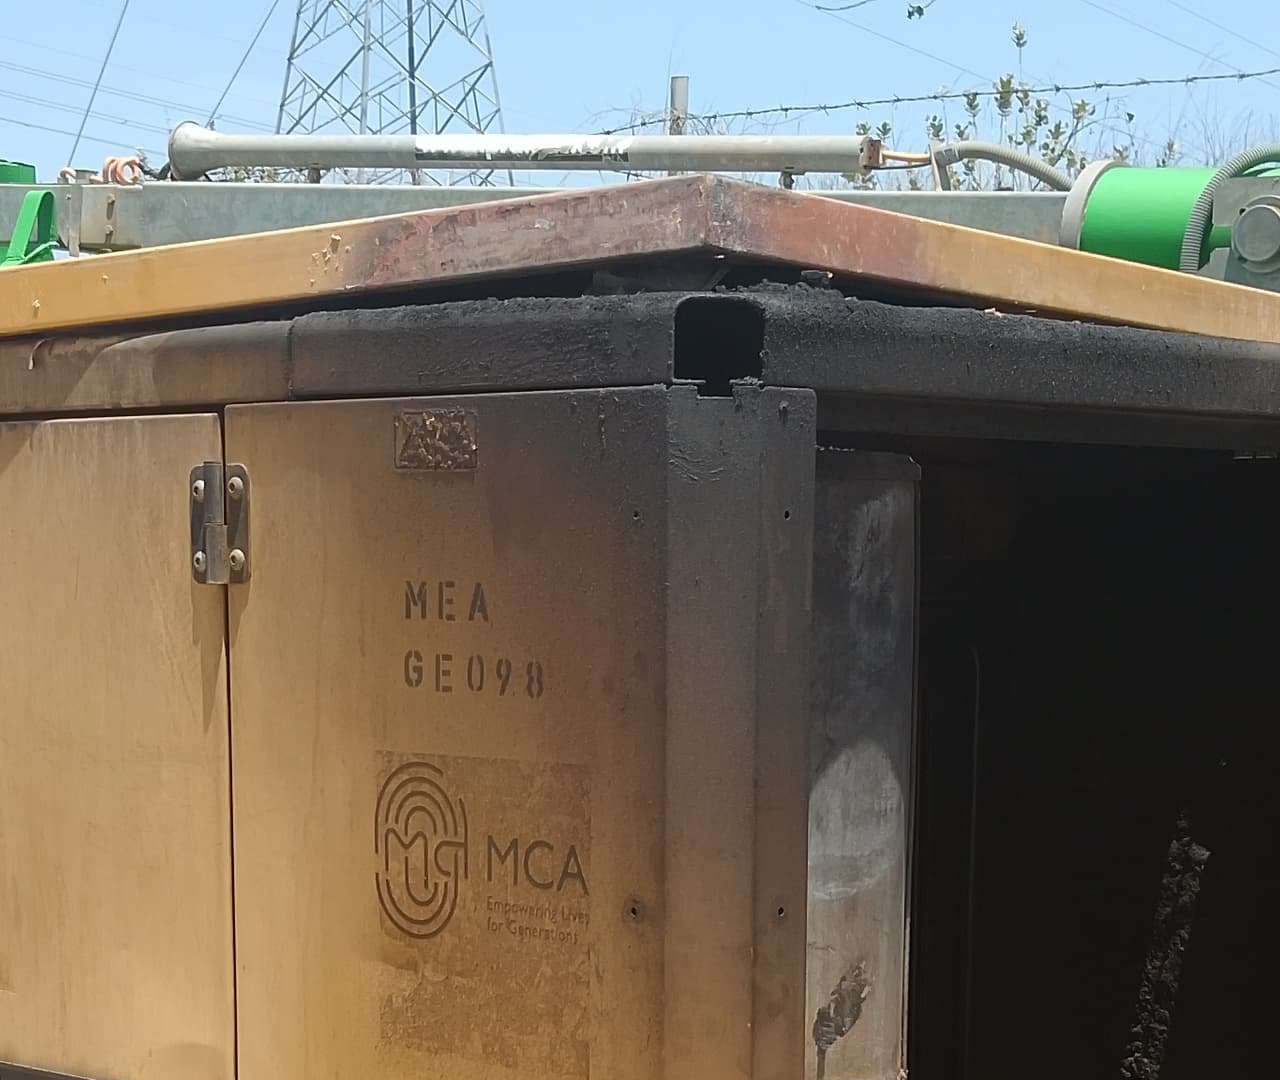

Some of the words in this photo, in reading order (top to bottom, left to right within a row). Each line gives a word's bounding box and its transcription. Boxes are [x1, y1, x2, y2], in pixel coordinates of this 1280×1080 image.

[404, 580, 489, 623] MEA
[403, 649, 545, 699] GE098
[486, 834, 590, 897] MCA
[487, 896, 558, 924] Empowering
